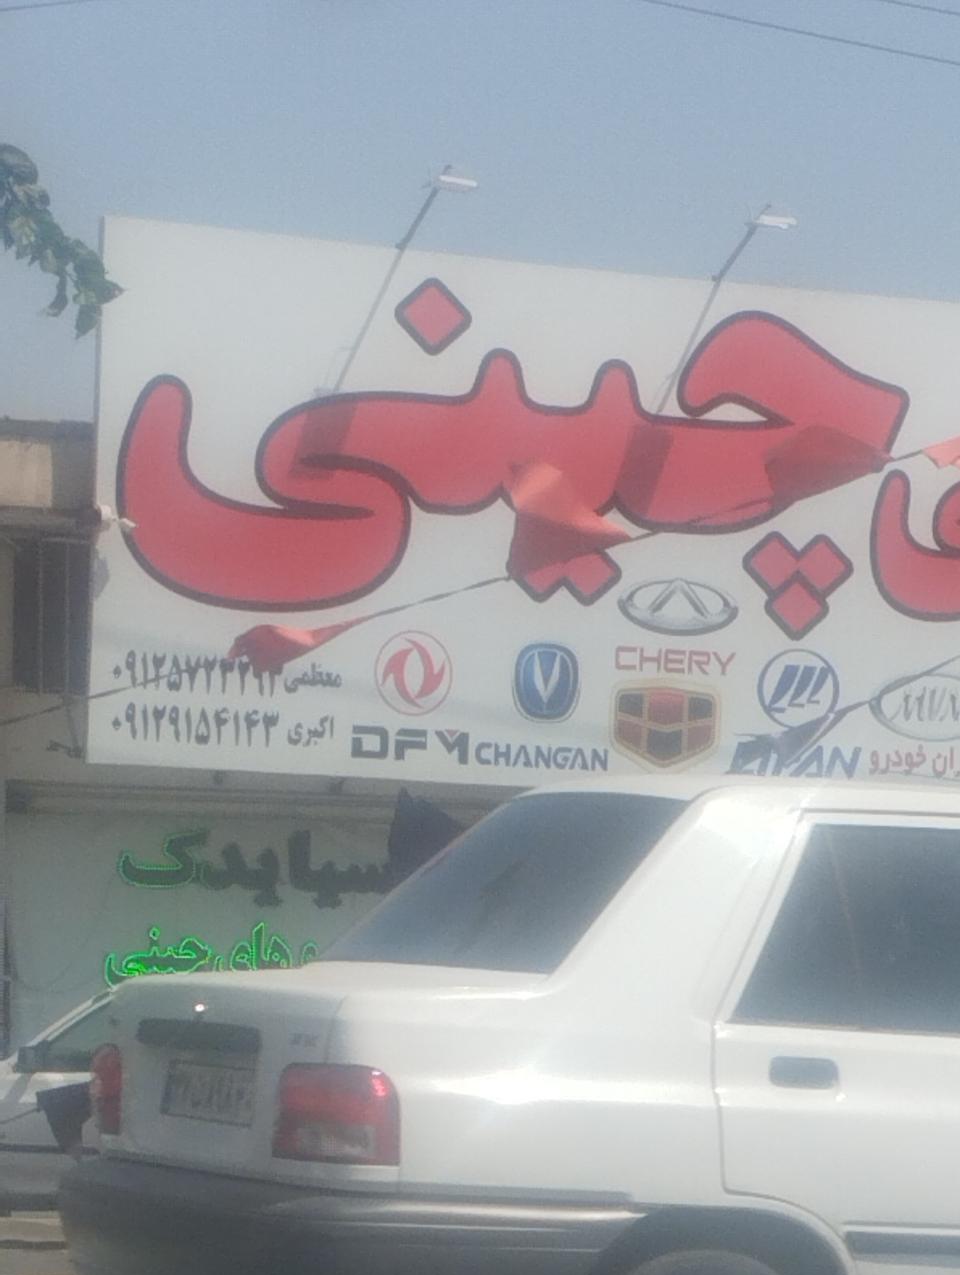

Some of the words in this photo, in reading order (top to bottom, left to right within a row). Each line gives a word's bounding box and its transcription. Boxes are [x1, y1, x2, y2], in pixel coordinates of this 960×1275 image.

[114, 276, 911, 641] چینی
[614, 645, 737, 677] CHERY
[111, 701, 280, 748] ۰۹۱۲۹۱۵۴۱۴۳
[350, 724, 471, 766] DFM
[474, 741, 610, 772] CHANGAN
[868, 745, 927, 776] خودرو
